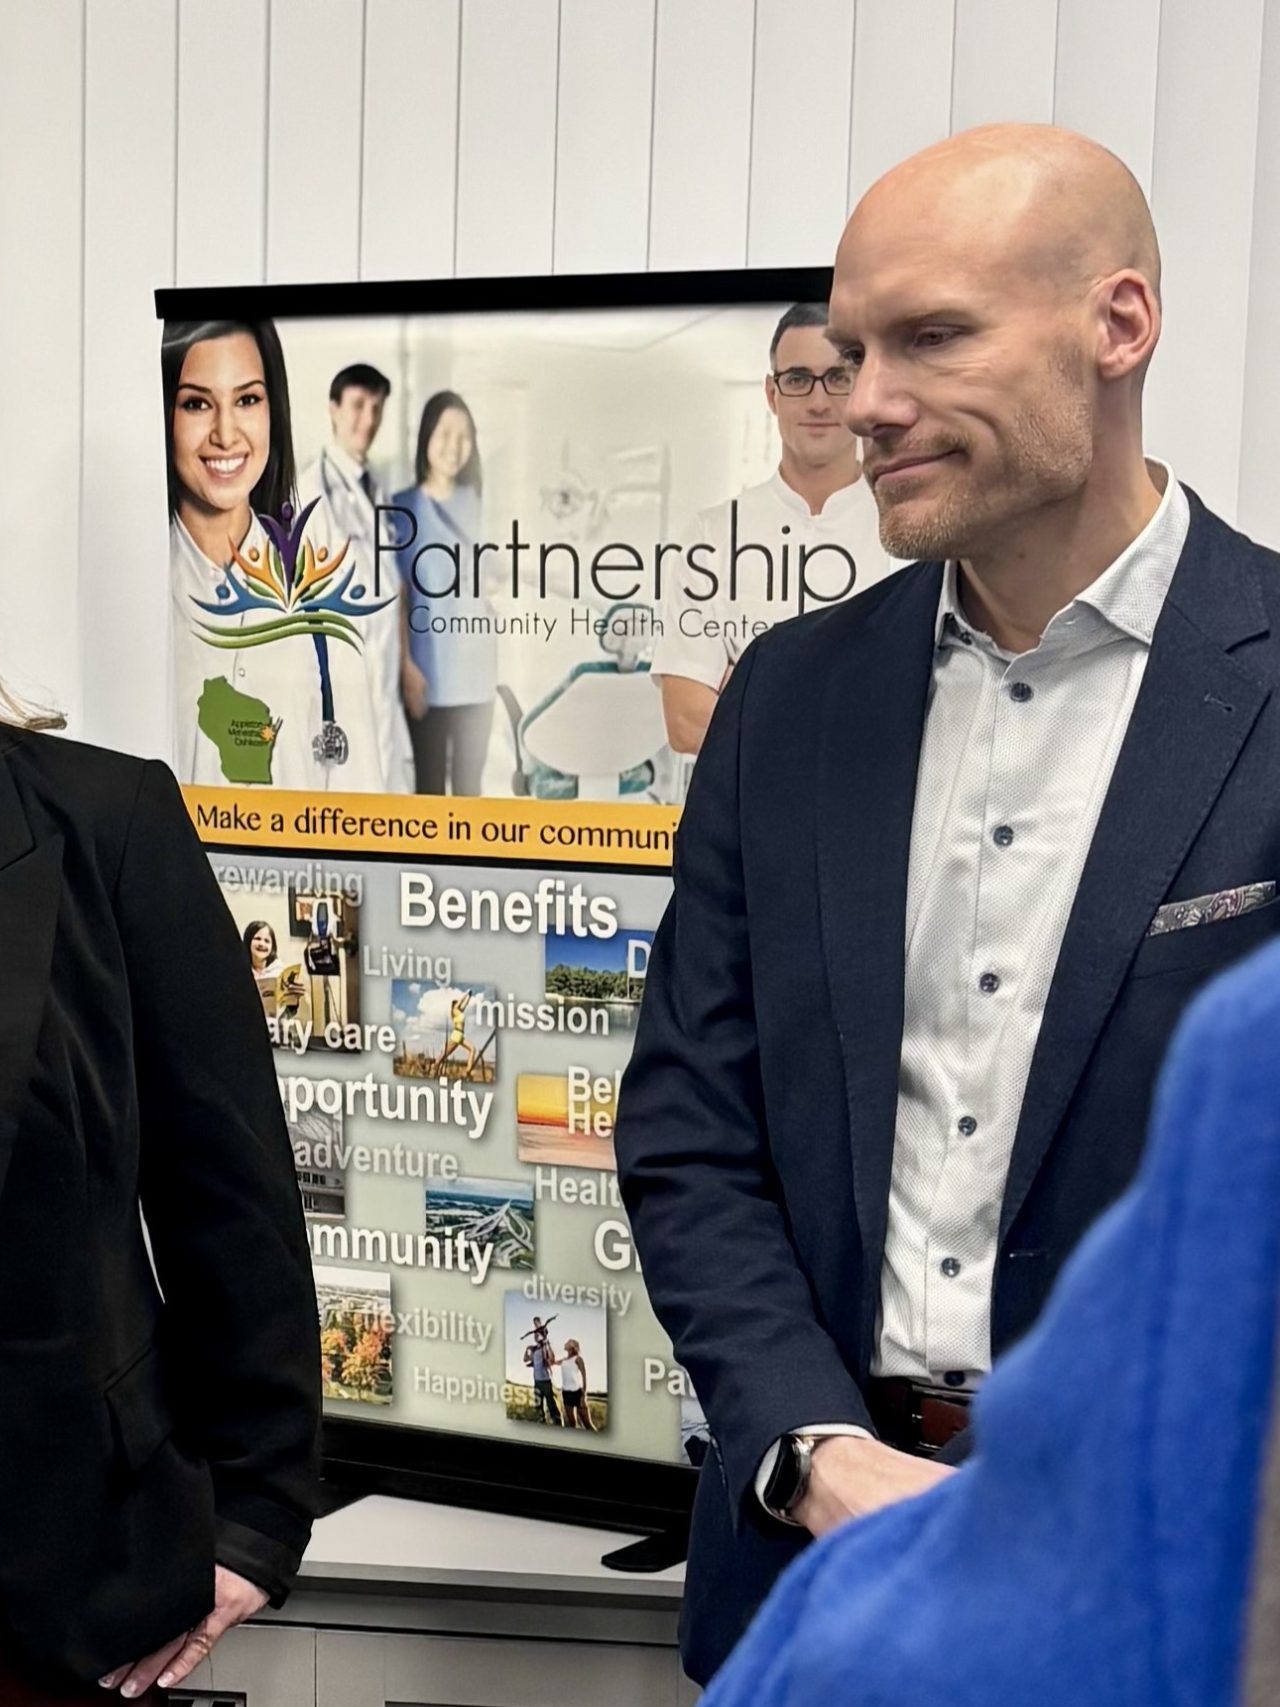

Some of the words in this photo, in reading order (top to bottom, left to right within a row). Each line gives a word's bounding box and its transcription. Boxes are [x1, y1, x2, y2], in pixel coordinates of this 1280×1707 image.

[374, 499, 857, 614] Partnership
[408, 605, 557, 642] Community
[571, 606, 664, 637] Health
[197, 803, 261, 831] Make
[270, 813, 284, 832] a
[294, 806, 438, 839] difference
[448, 812, 470, 840] in
[481, 821, 531, 843] our
[400, 871, 618, 939] Benefits
[363, 945, 452, 986] Living
[475, 993, 610, 1036] mission
[324, 1021, 397, 1053] care
[294, 1135, 459, 1181] adventure
[305, 1223, 494, 1285] mmunity
[523, 1274, 632, 1316] diversity
